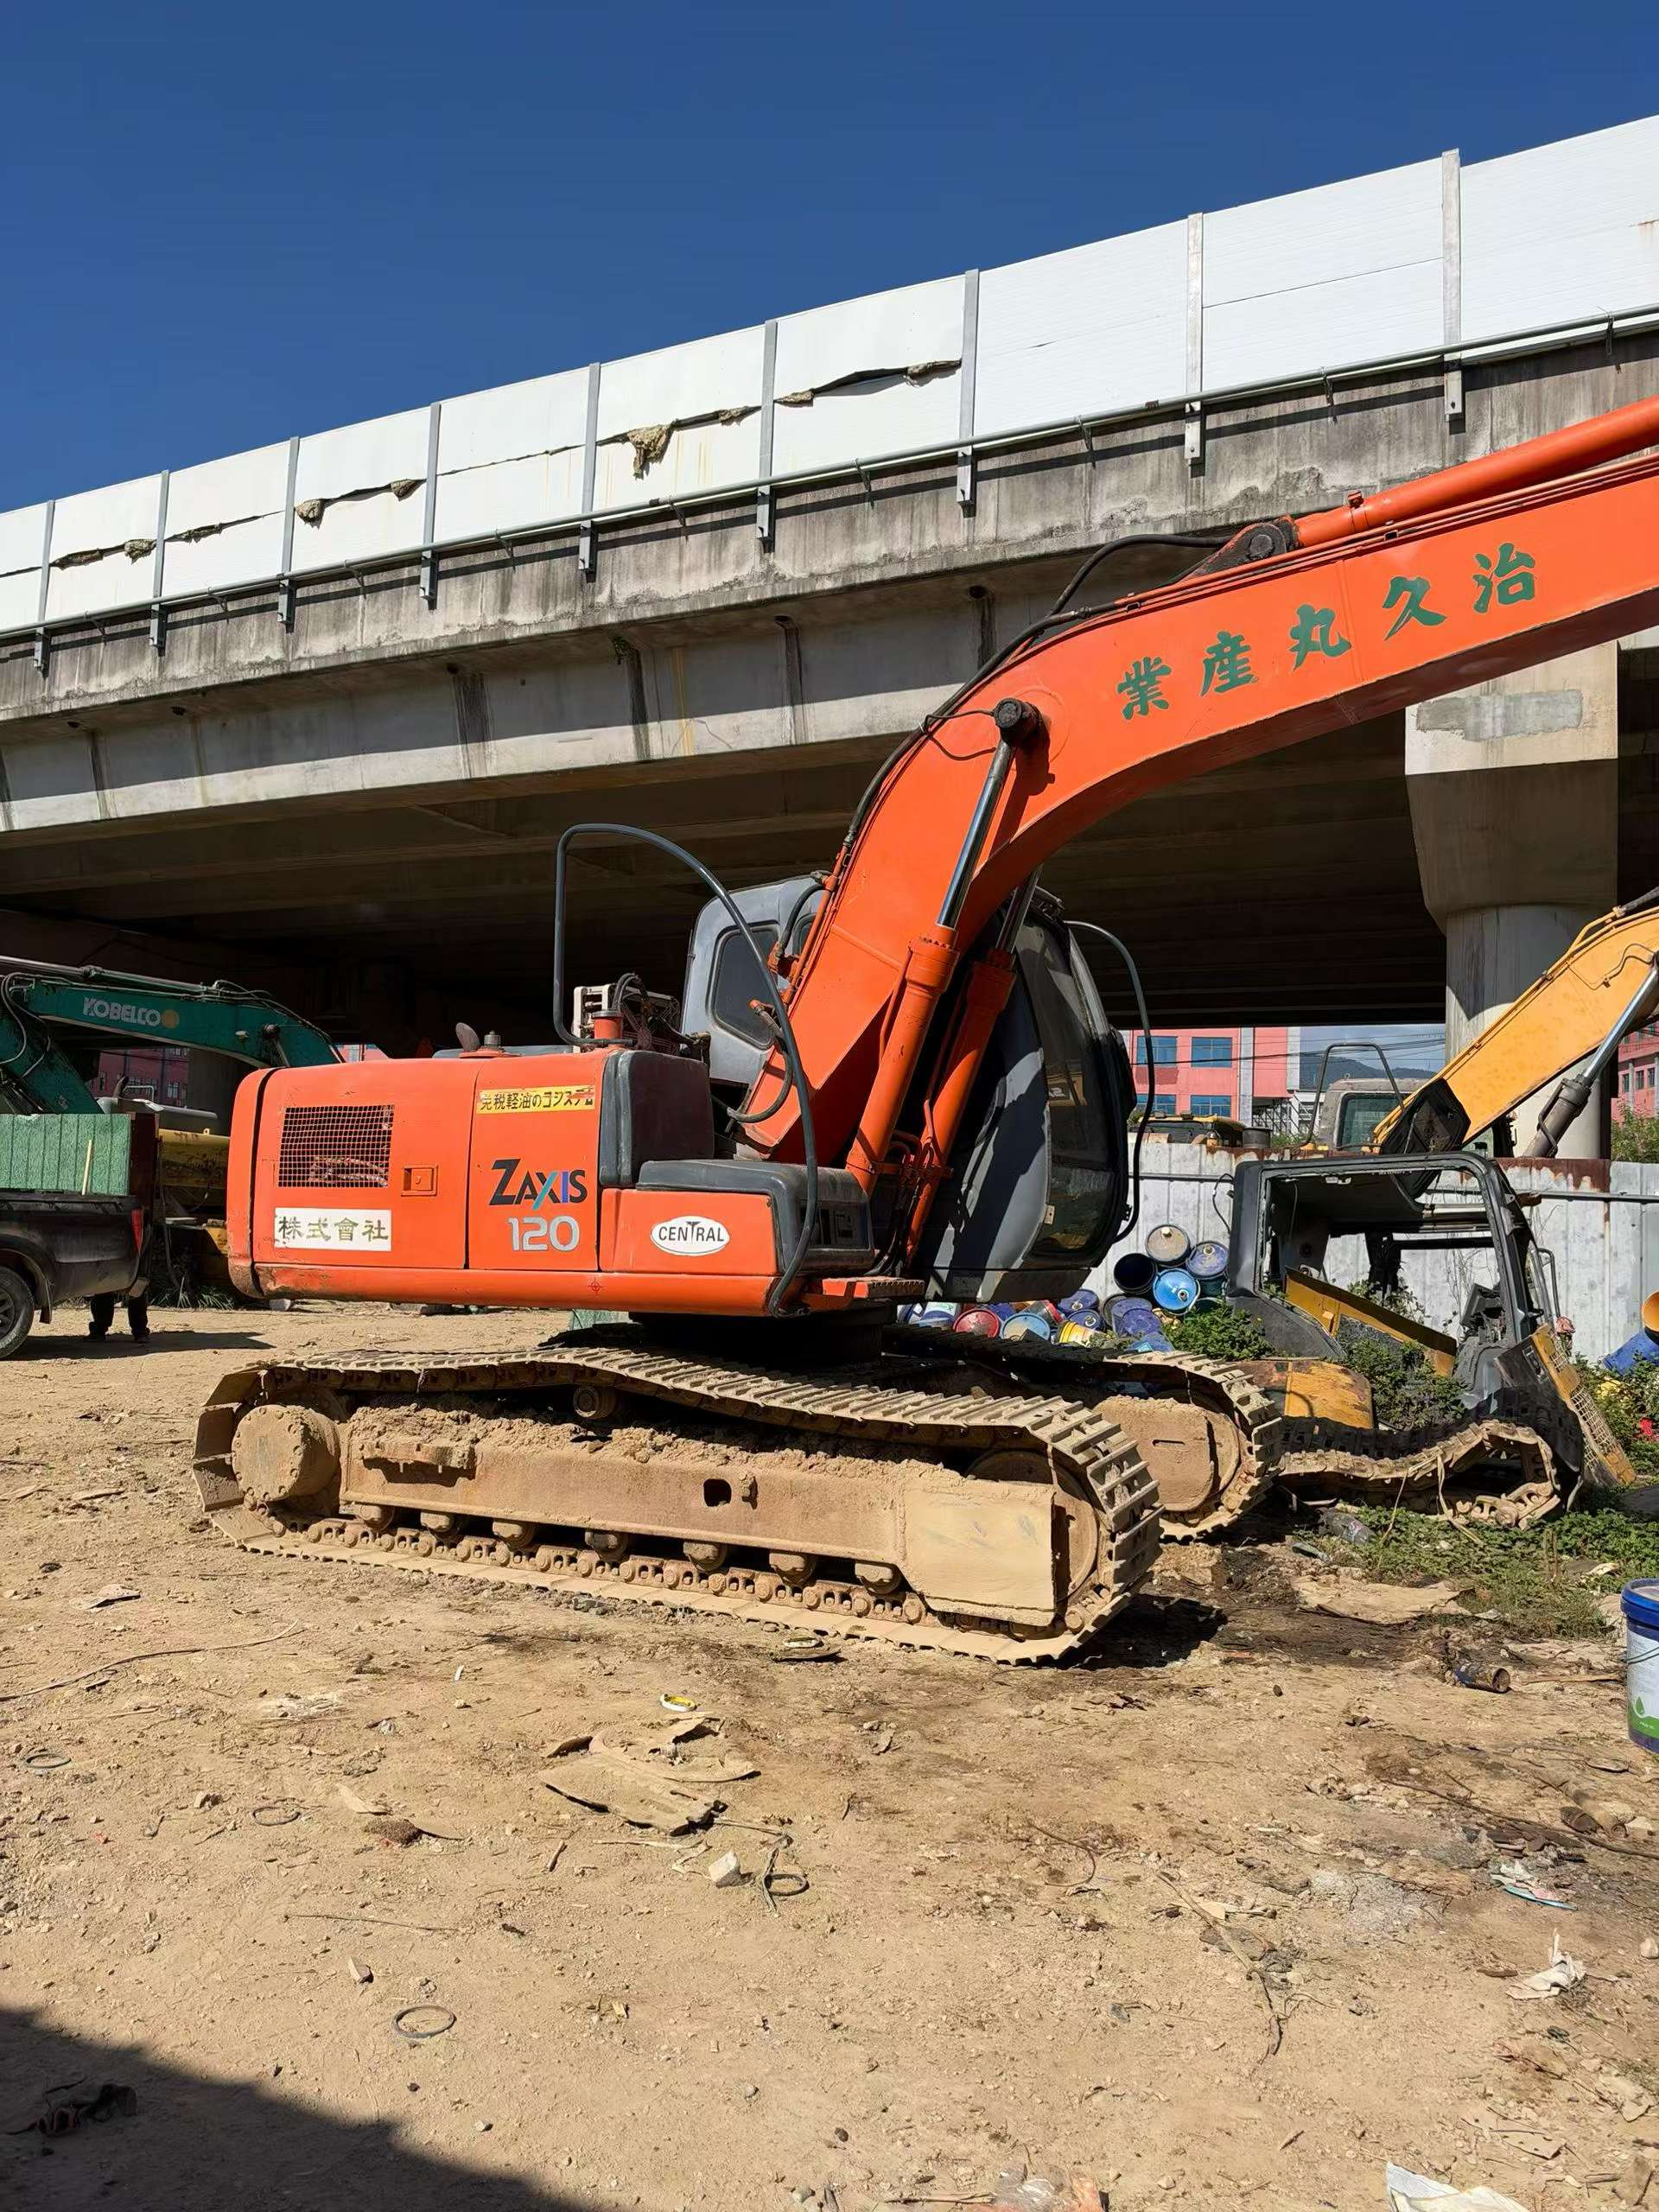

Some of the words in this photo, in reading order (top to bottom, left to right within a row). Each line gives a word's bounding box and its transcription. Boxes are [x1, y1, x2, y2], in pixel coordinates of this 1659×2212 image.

[82, 996, 161, 1027] KOBELCO
[489, 1158, 588, 1210] ZAXIS
[507, 1215, 580, 1252] 120
[658, 1221, 725, 1243] CENTRAL
